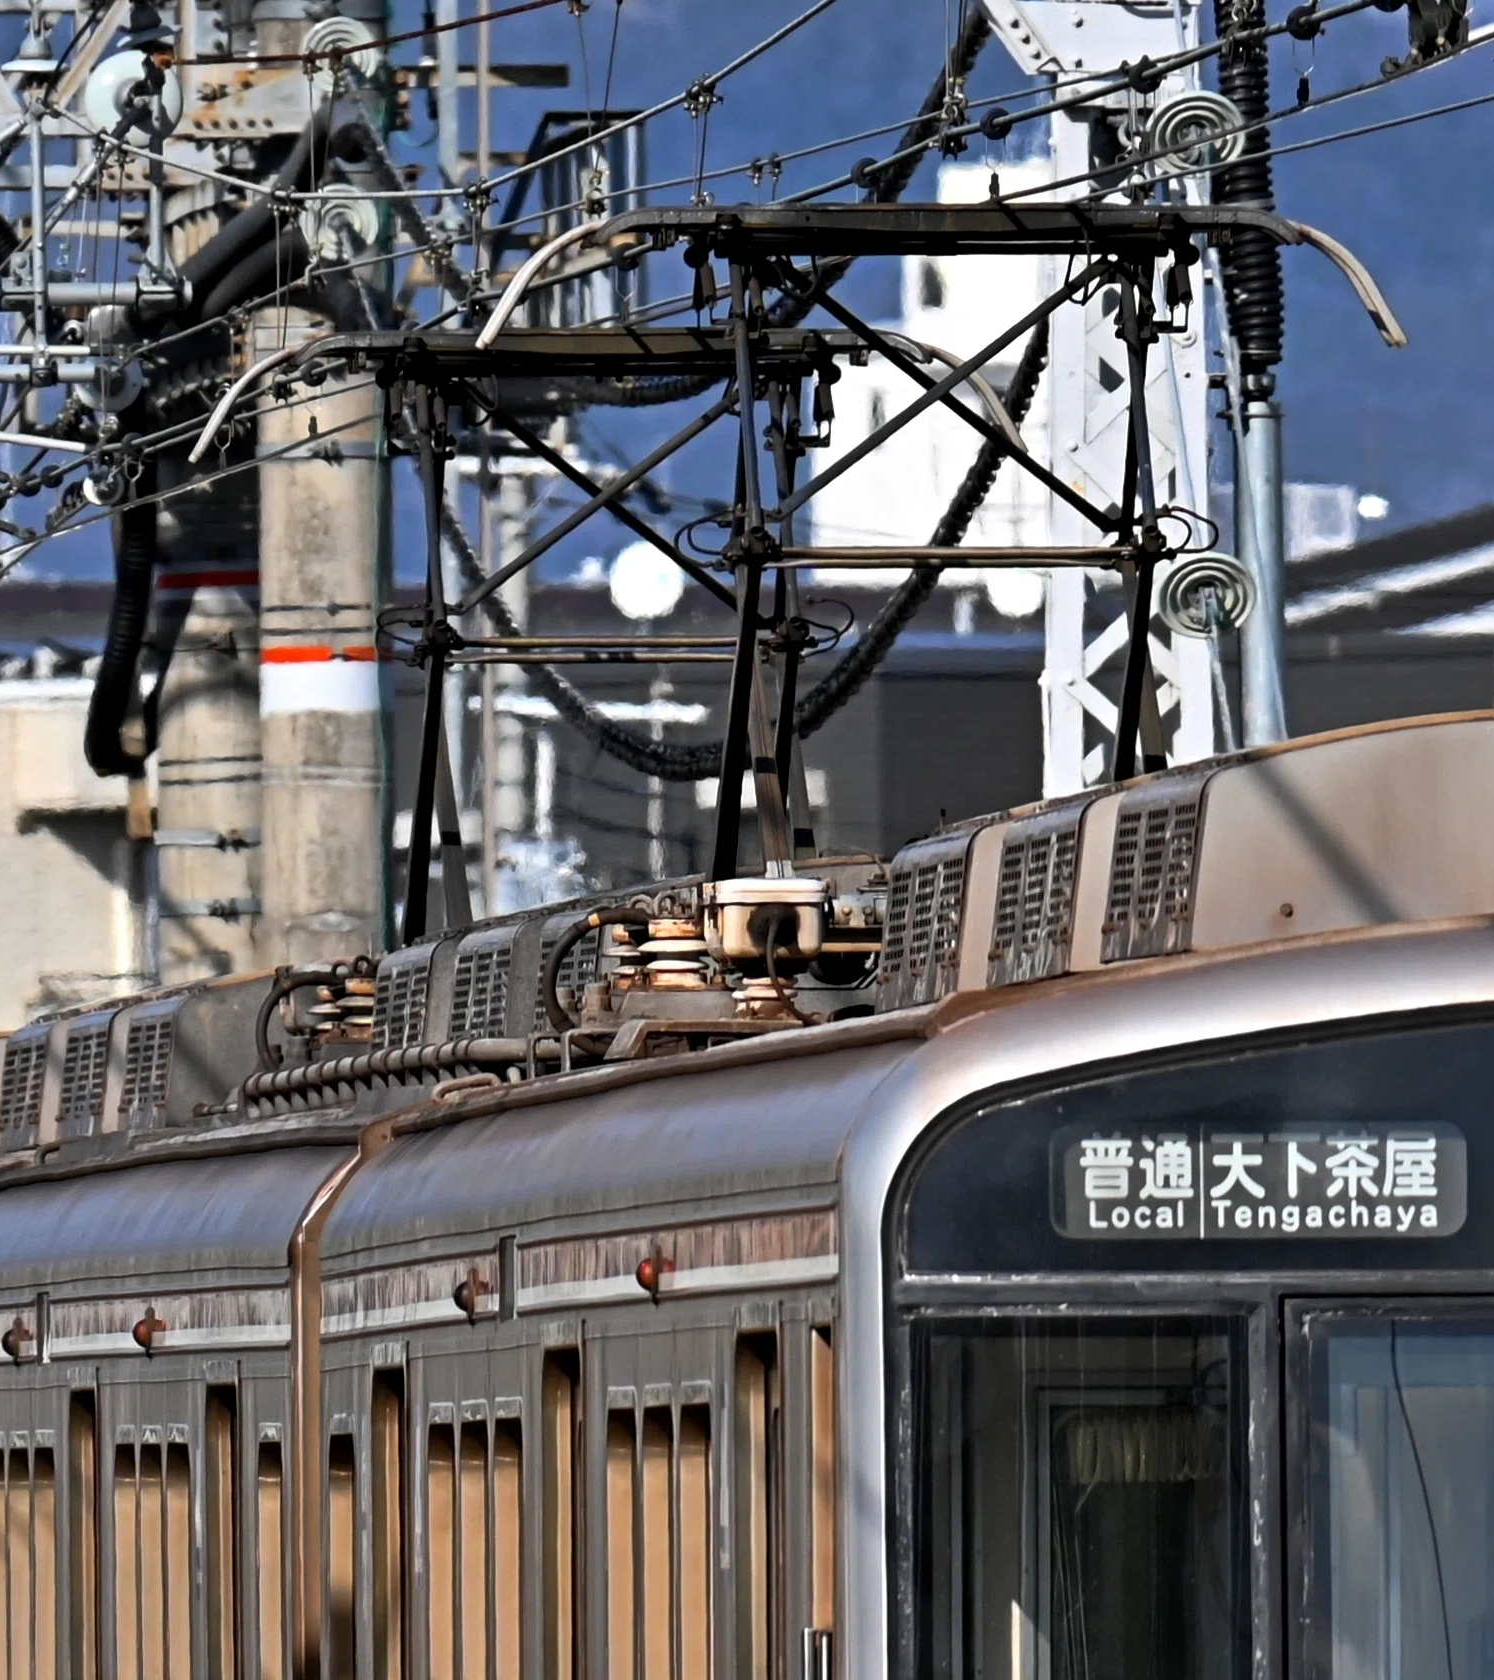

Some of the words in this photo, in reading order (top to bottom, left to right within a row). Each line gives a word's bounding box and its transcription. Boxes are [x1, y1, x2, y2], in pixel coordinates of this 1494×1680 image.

[1079, 1131, 1194, 1200] 普通
[1209, 1132, 1438, 1200] 天下茶屋
[1088, 1200, 1184, 1229] Local
[1209, 1200, 1438, 1232] Tengachaya
